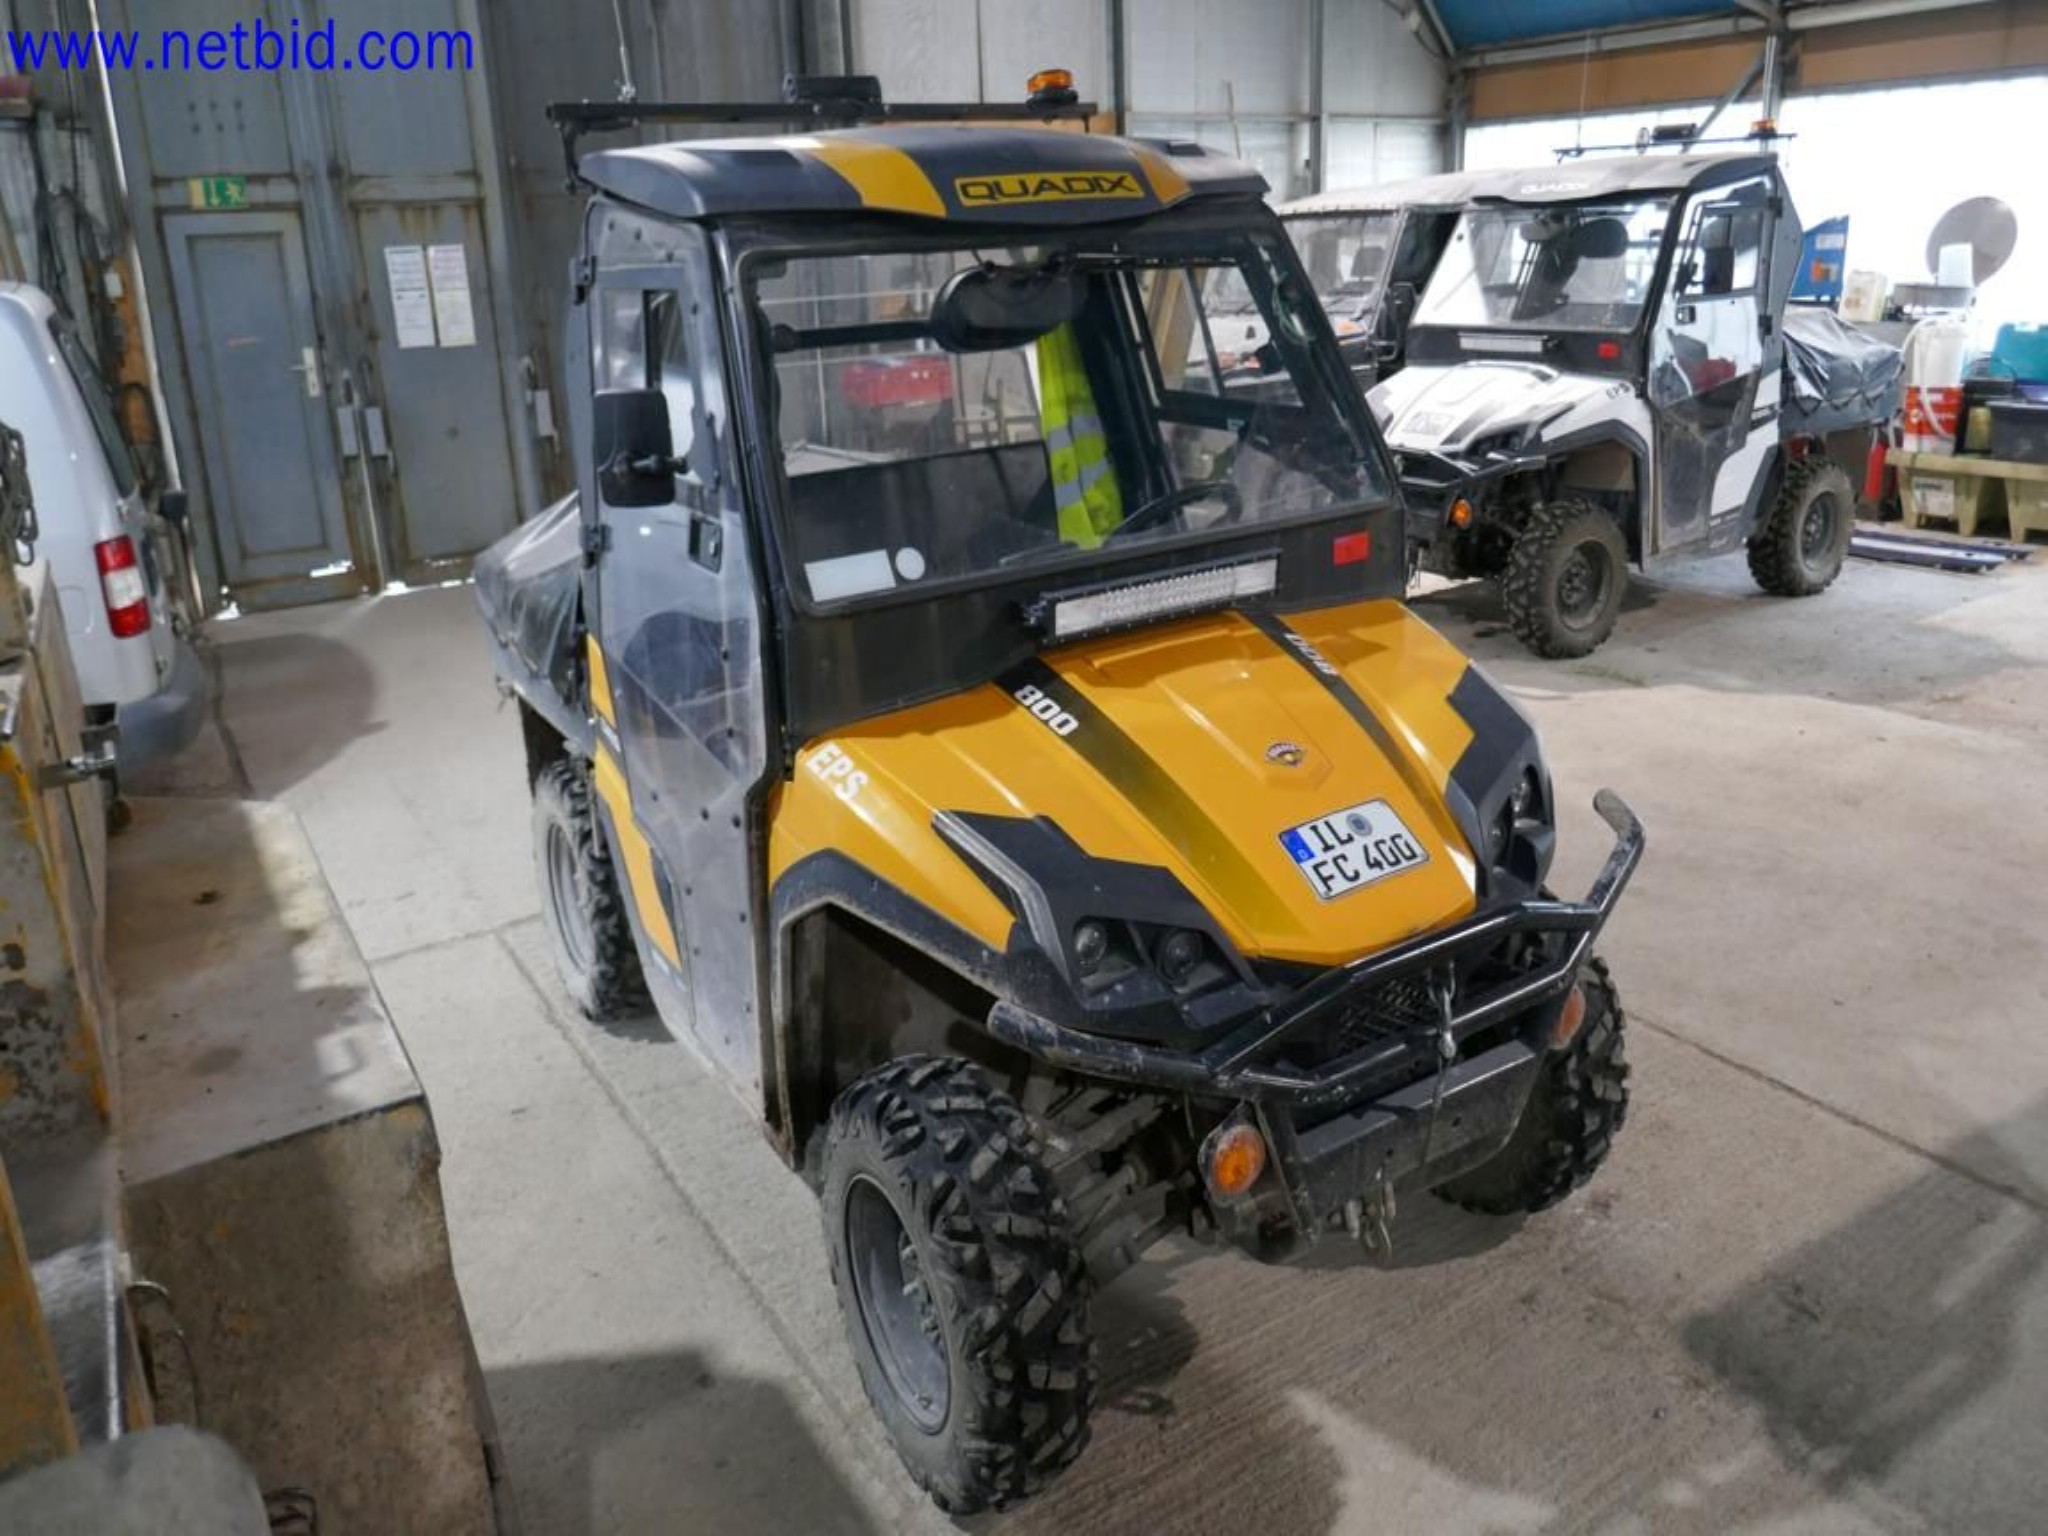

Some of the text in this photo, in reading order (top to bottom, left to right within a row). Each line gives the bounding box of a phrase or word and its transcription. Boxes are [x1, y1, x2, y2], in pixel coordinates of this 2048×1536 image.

[960, 175, 1136, 201] QUADIX
[1014, 685, 1079, 736] 800
[805, 741, 869, 801] EPS
[1309, 820, 1354, 853] IL
[1312, 853, 1361, 893] FC
